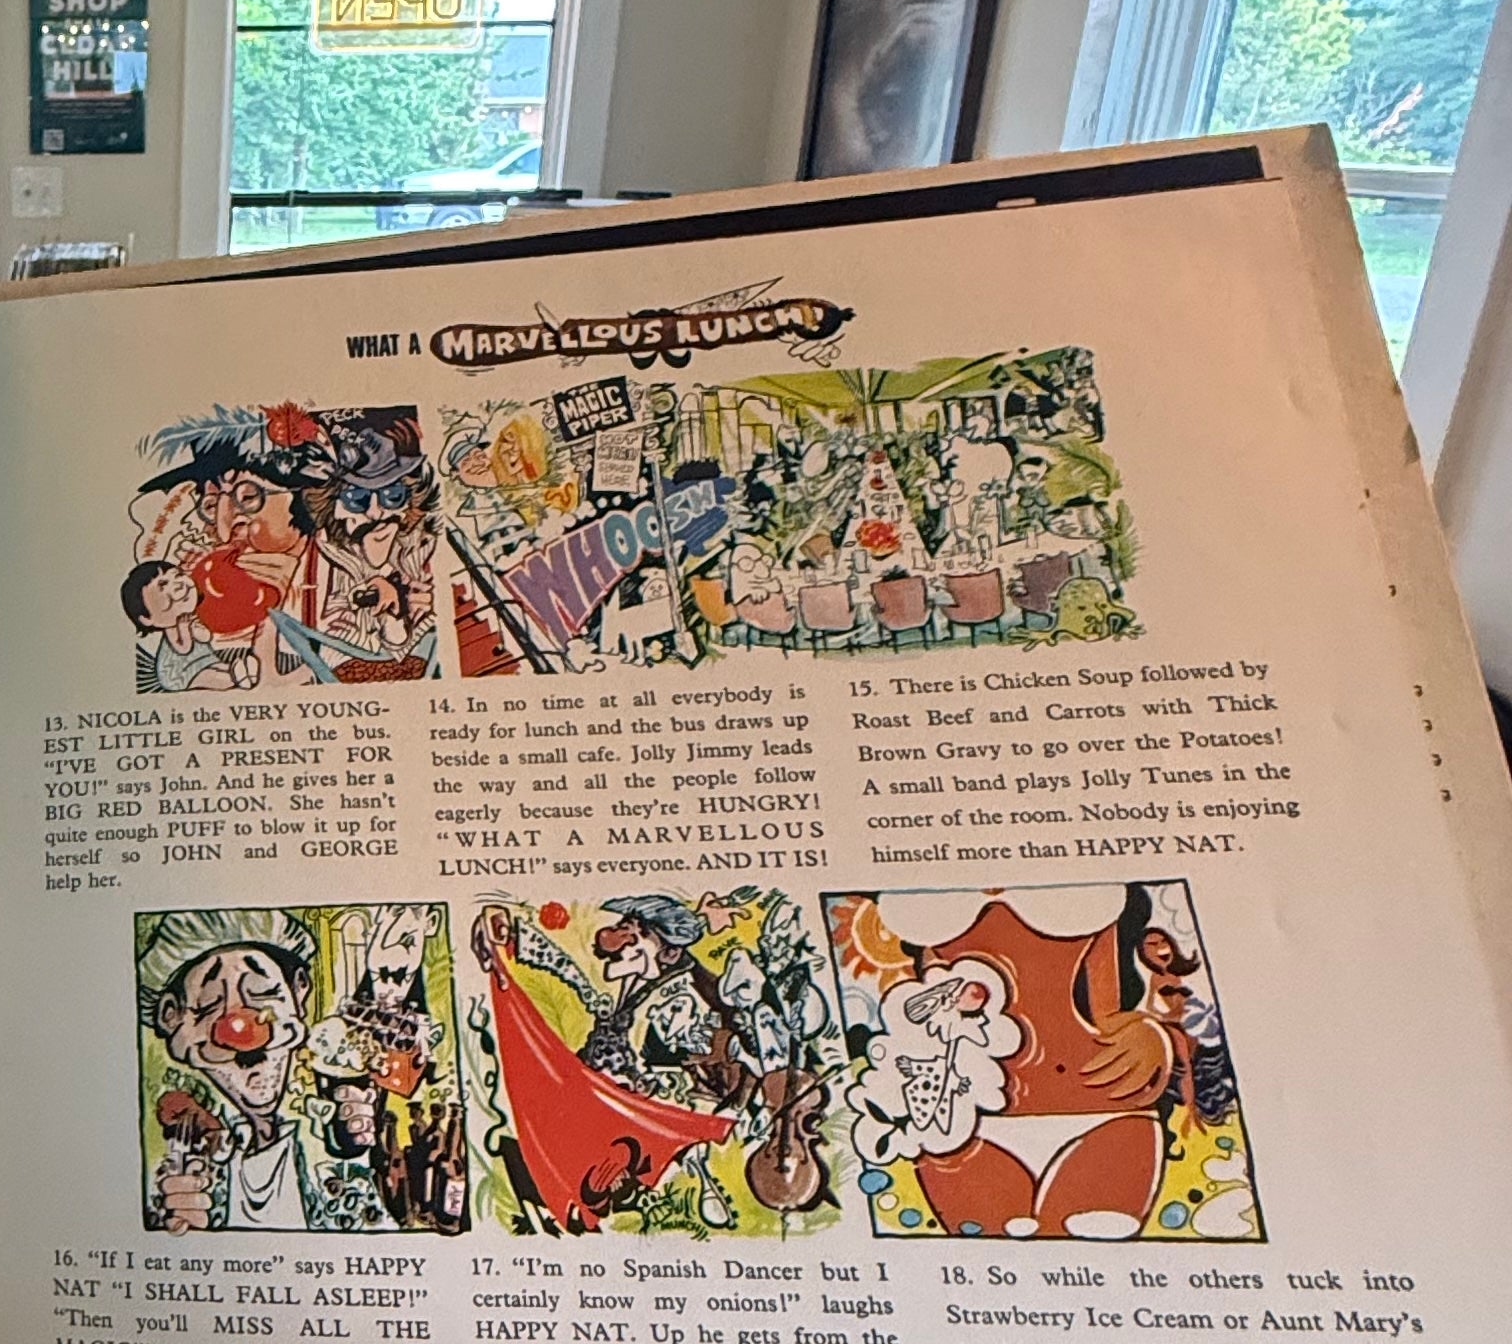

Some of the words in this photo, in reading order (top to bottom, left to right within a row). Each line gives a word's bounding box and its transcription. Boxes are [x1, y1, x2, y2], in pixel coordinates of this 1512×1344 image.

[53, 60, 113, 81] HILL
[347, 333, 399, 358] WHAT
[409, 332, 421, 356] A
[442, 321, 664, 361] MARVELLOUS
[676, 306, 824, 344] LUNCH!
[319, 408, 365, 426] PECK
[559, 386, 624, 423] MAGIC
[568, 406, 629, 436] PIPER
[503, 480, 716, 649] WHOOSH
[849, 680, 879, 697] 15.
[890, 678, 953, 695] There
[960, 675, 976, 692] is
[984, 671, 1071, 691] Chicken
[1078, 668, 1133, 688] Soup
[1140, 661, 1234, 683] followed
[1239, 660, 1268, 681] by
[430, 698, 455, 714] 14.
[467, 696, 487, 713] In
[503, 699, 526, 712] no
[542, 694, 584, 711] time
[600, 695, 618, 709] at
[633, 690, 656, 707] all
[672, 685, 772, 708] everybody
[789, 683, 805, 700] is
[852, 712, 911, 730] Roast
[926, 707, 974, 727] Beef
[990, 705, 1029, 724] and
[1046, 703, 1125, 721] Carrots
[1142, 697, 1192, 716] with
[1207, 693, 1278, 713] Thick
[46, 716, 67, 732] 13.
[78, 709, 161, 730] NICOLA
[171, 707, 184, 725] is
[193, 707, 220, 723] the
[229, 703, 287, 722] VERY
[297, 700, 389, 719] YOUNG-
[430, 723, 480, 744] ready
[489, 722, 516, 739] for
[525, 720, 578, 738] lunch
[587, 718, 622, 736] and
[631, 717, 662, 734] the
[670, 716, 705, 733] bus
[715, 714, 773, 731] draws
[783, 714, 808, 732] up
[44, 736, 84, 754] EST
[99, 730, 182, 751] LITTLE
[198, 727, 254, 745] GIRL
[270, 730, 292, 743] on
[309, 724, 337, 742] the
[352, 723, 390, 741] bus.
[858, 745, 926, 763] Brown
[936, 741, 1001, 761] Gravy
[1011, 742, 1033, 756] to
[1043, 741, 1068, 759] go
[1078, 739, 1125, 754] over
[1134, 733, 1170, 751] the
[1178, 727, 1282, 749] Potatoes!
[434, 777, 462, 794] the
[479, 780, 516, 797] way
[533, 774, 568, 792] and
[585, 773, 607, 790] all
[624, 772, 655, 789] the
[672, 768, 737, 792] people
[754, 766, 815, 785] follow
[46, 803, 82, 821] BIG
[97, 800, 142, 819] RED
[159, 795, 272, 816] BALLOON.
[290, 794, 323, 811] She
[340, 791, 395, 809] hasn't
[45, 847, 102, 867] herself
[122, 851, 140, 864] so
[162, 843, 221, 866] JOHN
[244, 842, 277, 859] and
[301, 838, 398, 858] GEORGE
[871, 843, 950, 864] himself
[957, 846, 1012, 861] more
[1018, 840, 1068, 859] than
[1074, 836, 1165, 857] HAPPY
[1173, 833, 1244, 854] NAT.
[472, 1257, 500, 1276] 17.
[513, 1257, 563, 1277] “I'm
[580, 1263, 605, 1278] no
[624, 1258, 707, 1283] Spanish
[723, 1259, 803, 1282] Dancer
[820, 1261, 859, 1282] but
[877, 1262, 888, 1282] I
[941, 1265, 973, 1286] 18.
[988, 1265, 1017, 1287] So
[1041, 1265, 1105, 1287] while
[1130, 1267, 1168, 1288] the
[1189, 1268, 1263, 1290] others
[1287, 1269, 1343, 1291] tuck
[1363, 1269, 1414, 1293] into
[54, 1277, 100, 1298] NAT
[113, 1281, 132, 1300] “I
[146, 1282, 223, 1304] SHALL
[236, 1285, 301, 1306] FALL
[313, 1287, 427, 1309] ASLEEP!”
[476, 1320, 558, 1341] HAPPY
[571, 1321, 636, 1343] NAT.
[698, 1323, 723, 1344] he
[947, 1304, 1075, 1332] Strawberry
[1085, 1306, 1123, 1328] Ice
[1133, 1307, 1214, 1330] Cream
[1224, 1314, 1249, 1331] or
[1261, 1309, 1324, 1332] Aunt
[1334, 1310, 1423, 1339] Mary's
